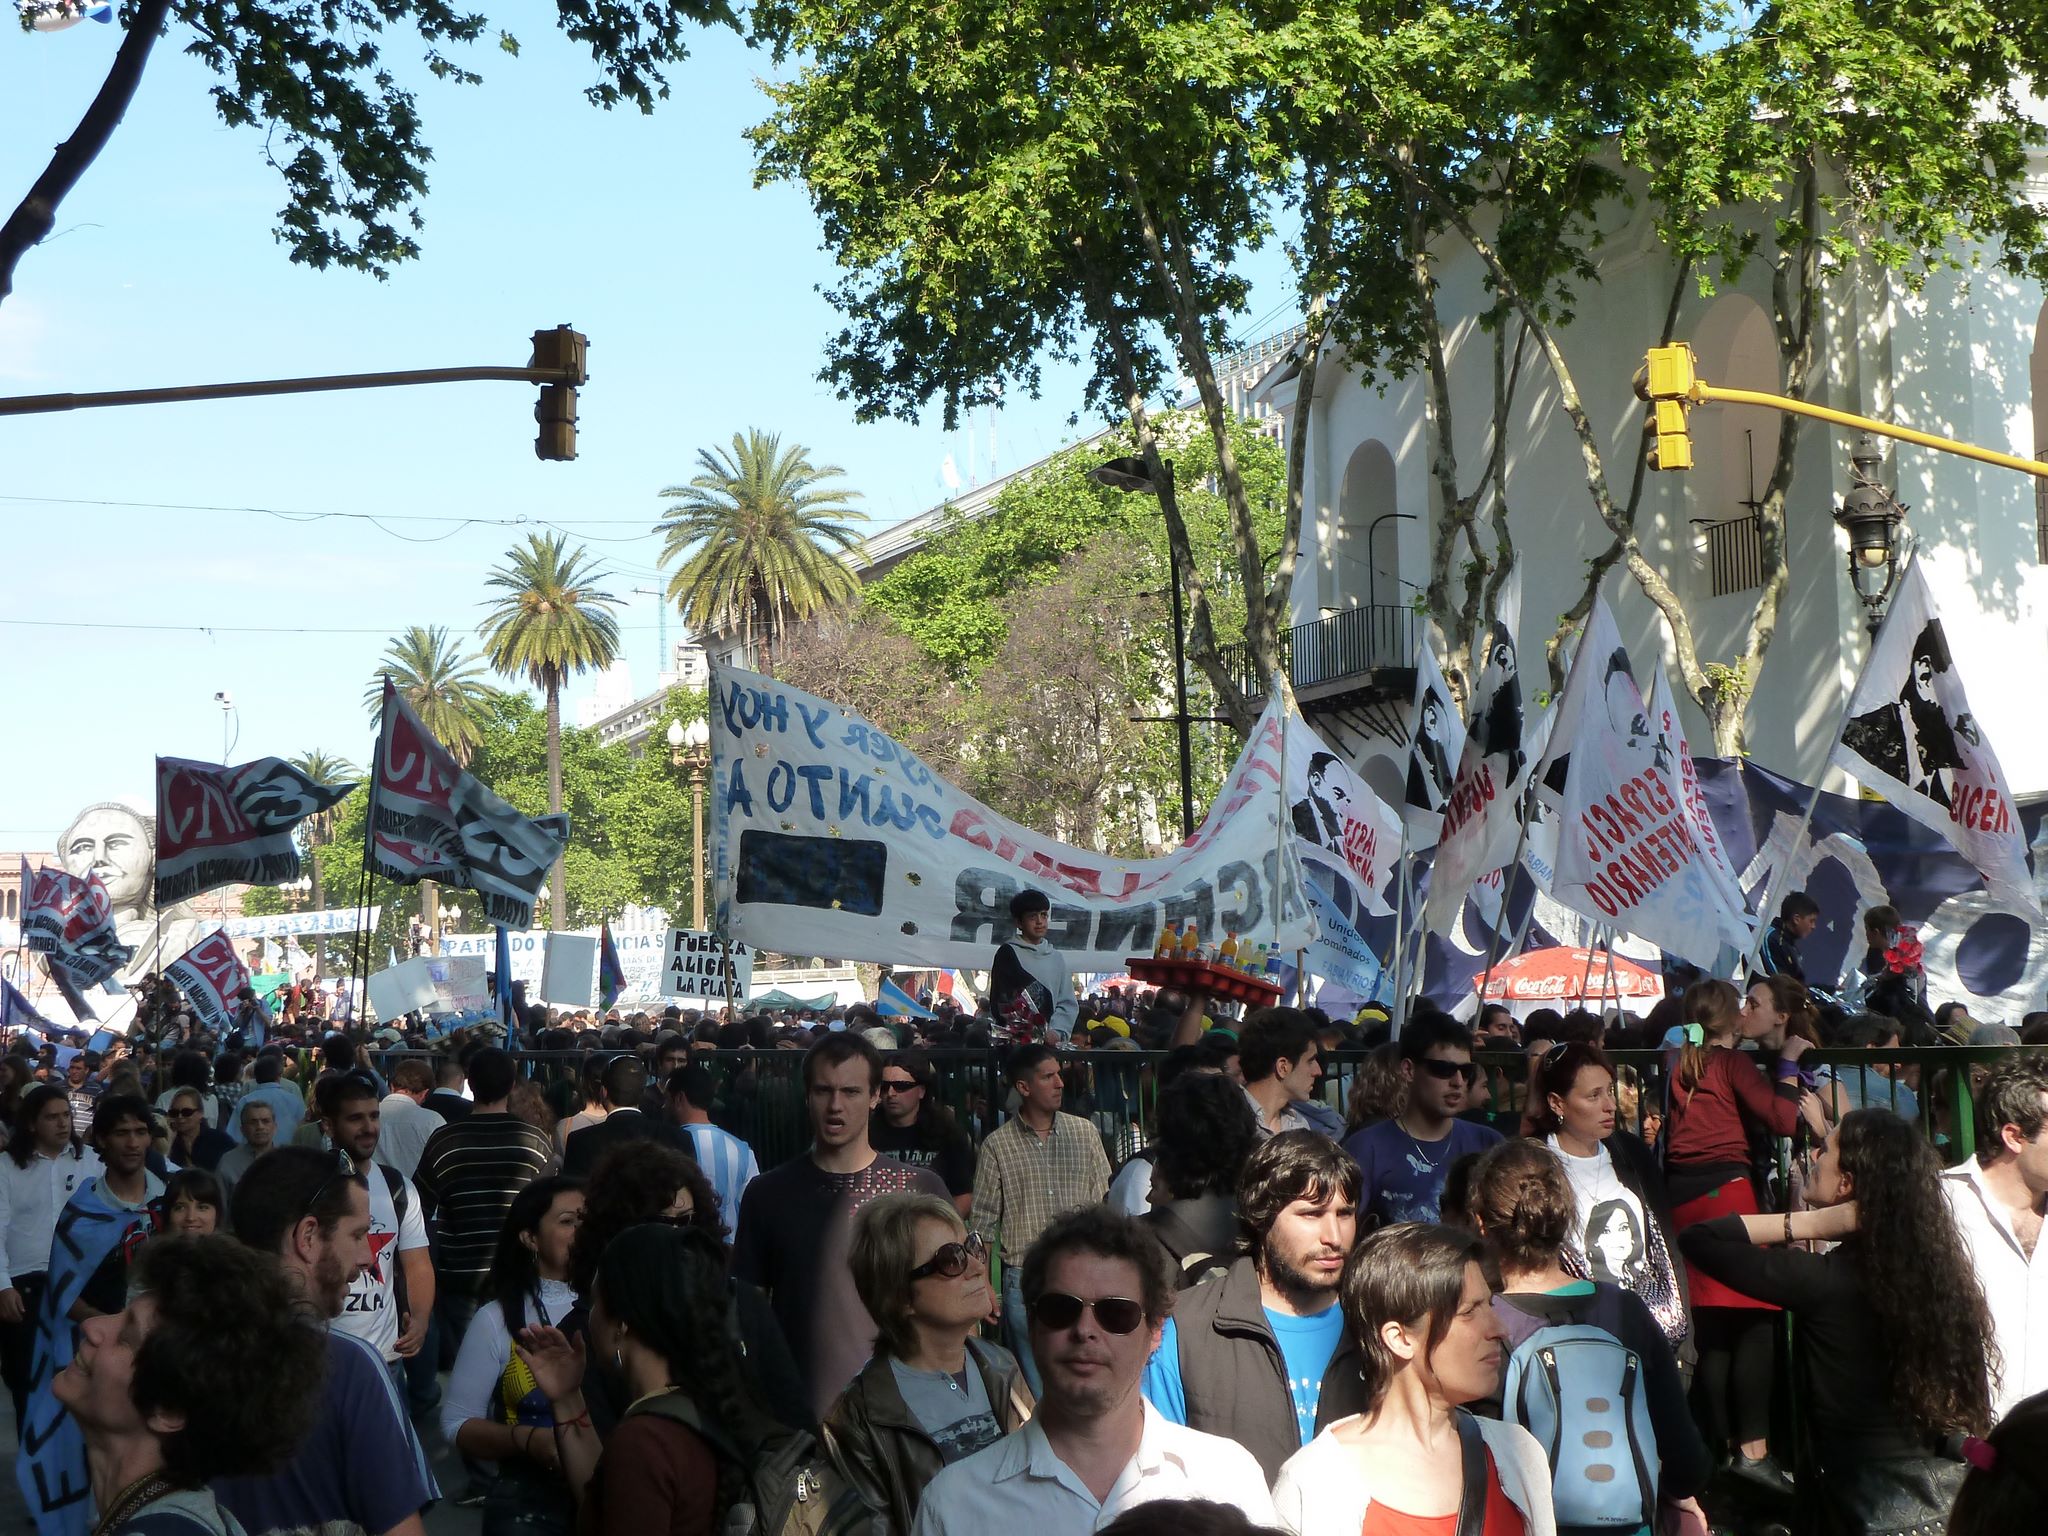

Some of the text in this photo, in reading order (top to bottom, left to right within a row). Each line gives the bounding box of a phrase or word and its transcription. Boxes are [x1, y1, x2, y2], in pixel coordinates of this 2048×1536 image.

[1949, 781, 2016, 834] BICEN
[1328, 917, 1364, 945] Unidos
[448, 937, 535, 953] PARTDO
[676, 975, 695, 994] LA
[1514, 975, 1568, 995] Coca-Cola
